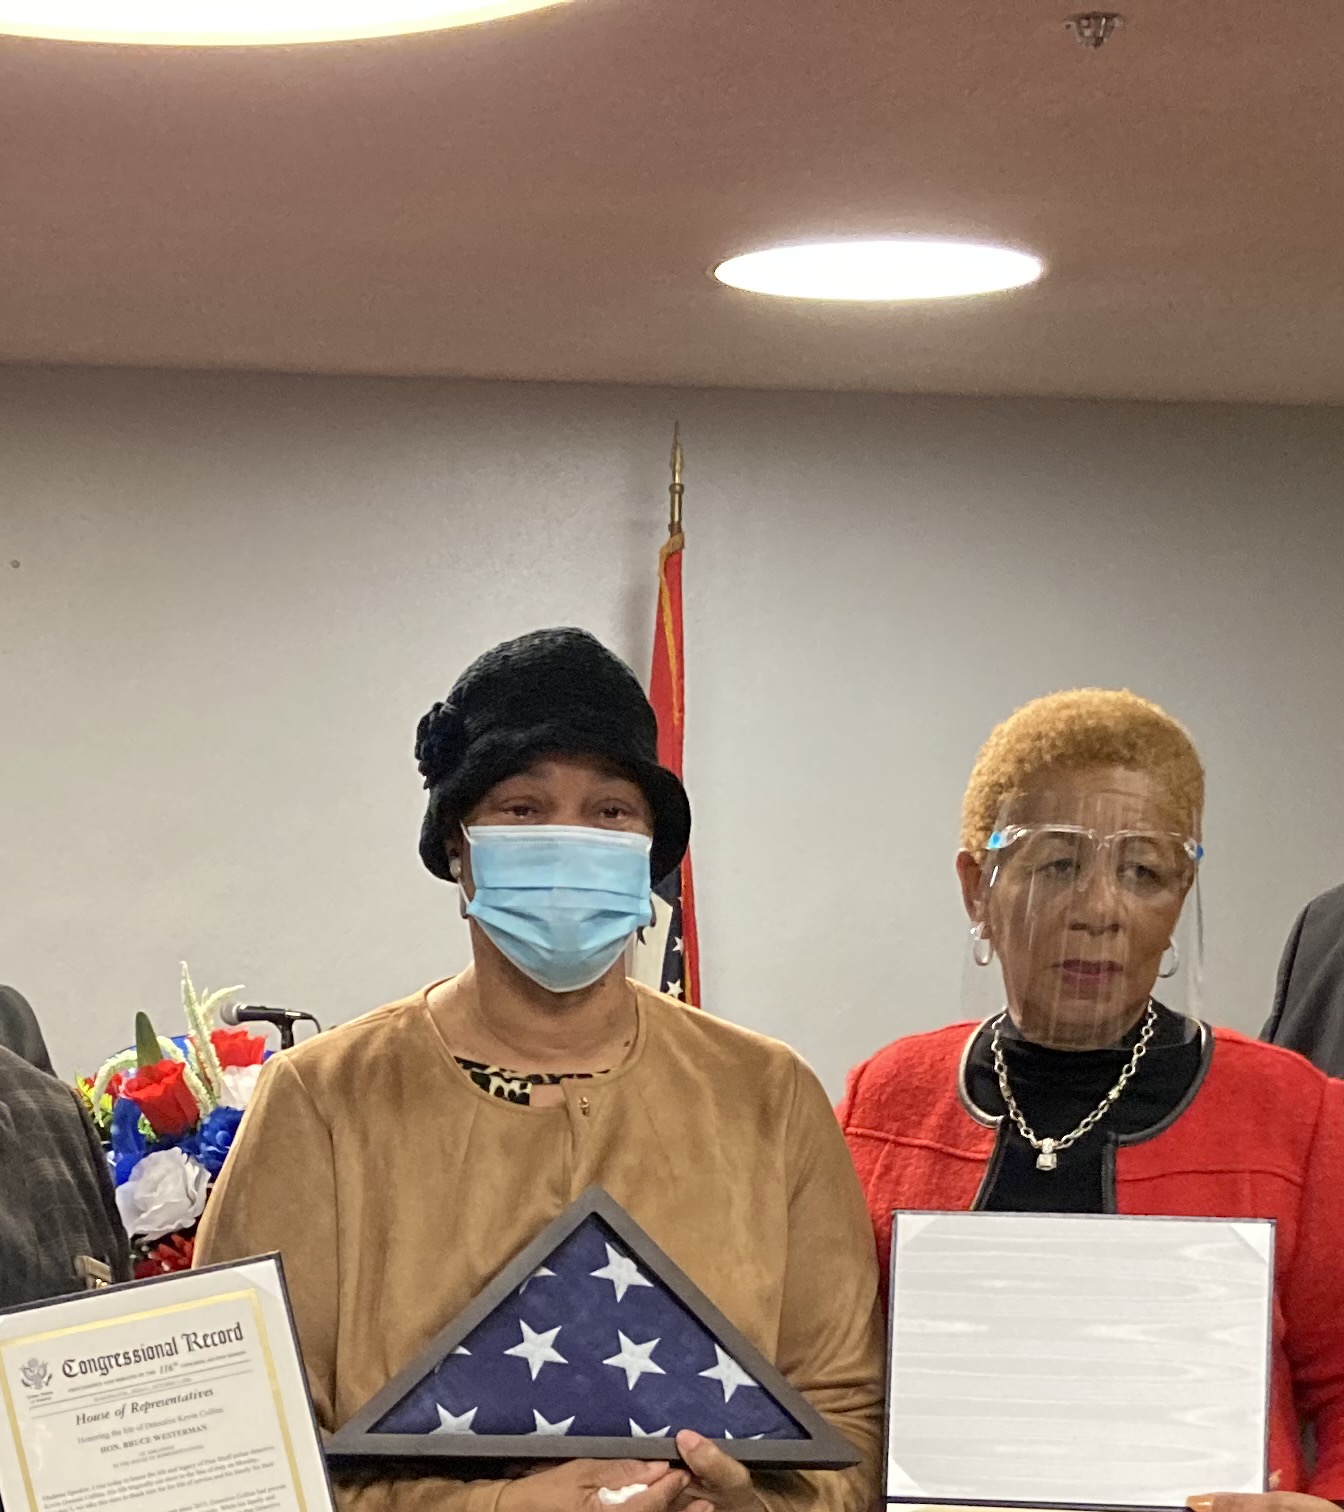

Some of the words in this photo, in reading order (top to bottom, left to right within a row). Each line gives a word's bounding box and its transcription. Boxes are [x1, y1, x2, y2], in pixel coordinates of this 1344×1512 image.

[61, 1336, 178, 1378] Congressional
[181, 1321, 243, 1352] Record
[75, 1409, 110, 1426] House
[114, 1403, 125, 1419] of
[130, 1386, 214, 1415] Representatives
[122, 1436, 151, 1448] BRUCE
[152, 1424, 207, 1441] WESTERMAN
